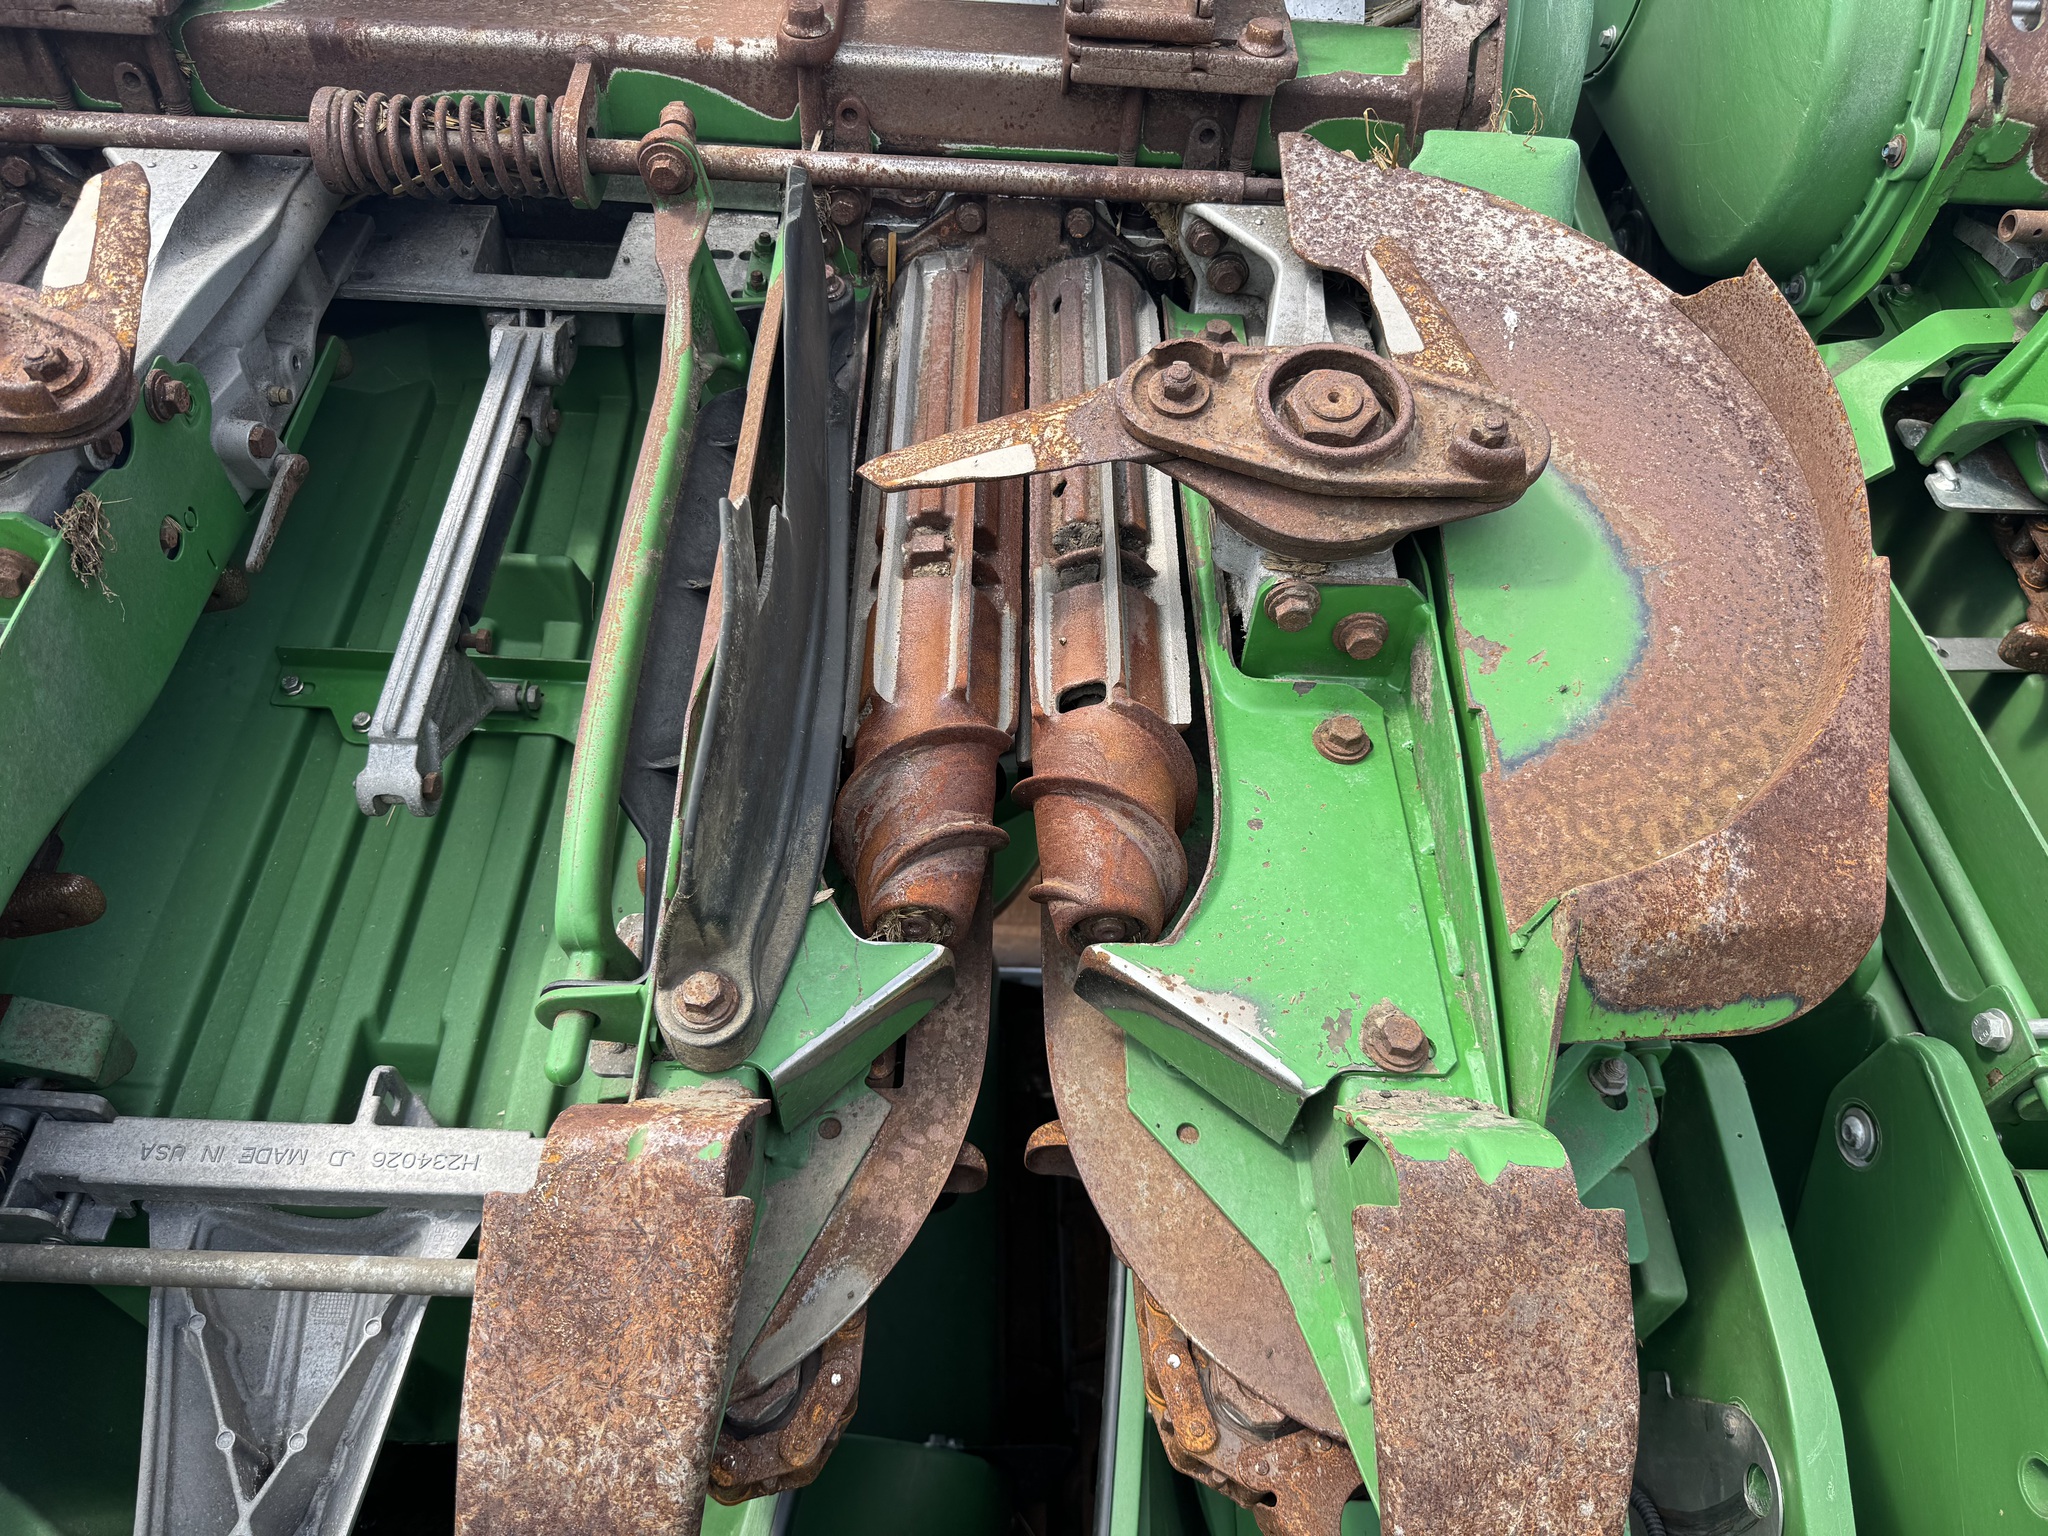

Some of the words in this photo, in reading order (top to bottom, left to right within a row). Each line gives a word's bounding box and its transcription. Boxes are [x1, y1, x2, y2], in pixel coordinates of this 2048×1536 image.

[140, 1142, 187, 1162] USA
[200, 1145, 226, 1163] IN
[237, 1146, 309, 1166] MADE
[371, 1151, 481, 1171] H234026
